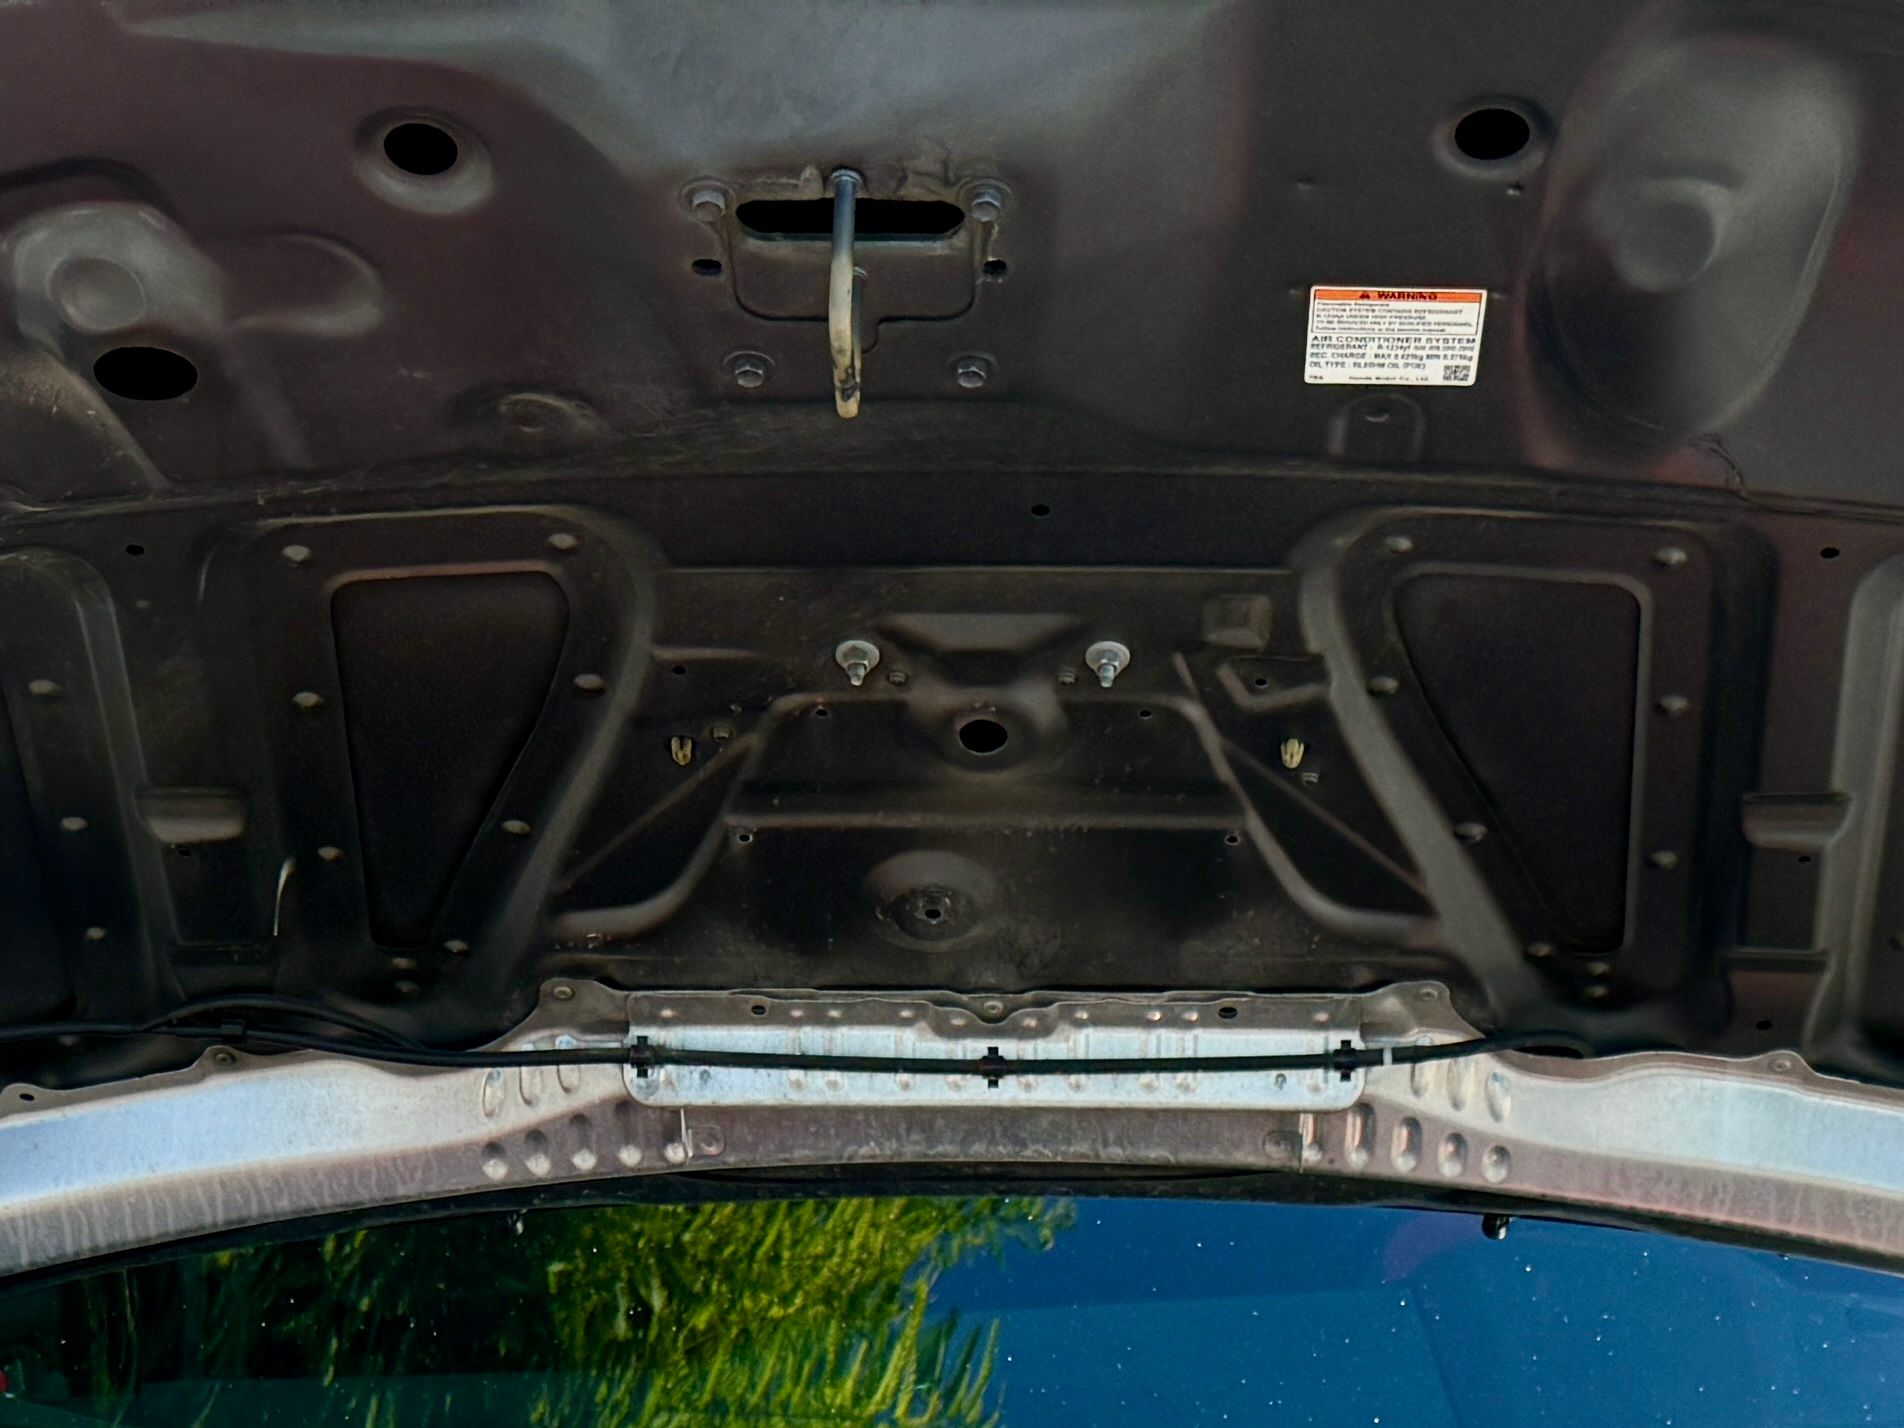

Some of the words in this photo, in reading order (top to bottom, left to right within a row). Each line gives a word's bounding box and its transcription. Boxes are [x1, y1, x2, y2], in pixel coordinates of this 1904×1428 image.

[1377, 290, 1438, 301] WARNING
[1312, 335, 1333, 343] AIR
[1336, 335, 1423, 344] CONDITIONER
[1425, 337, 1476, 345] SYSTEM
